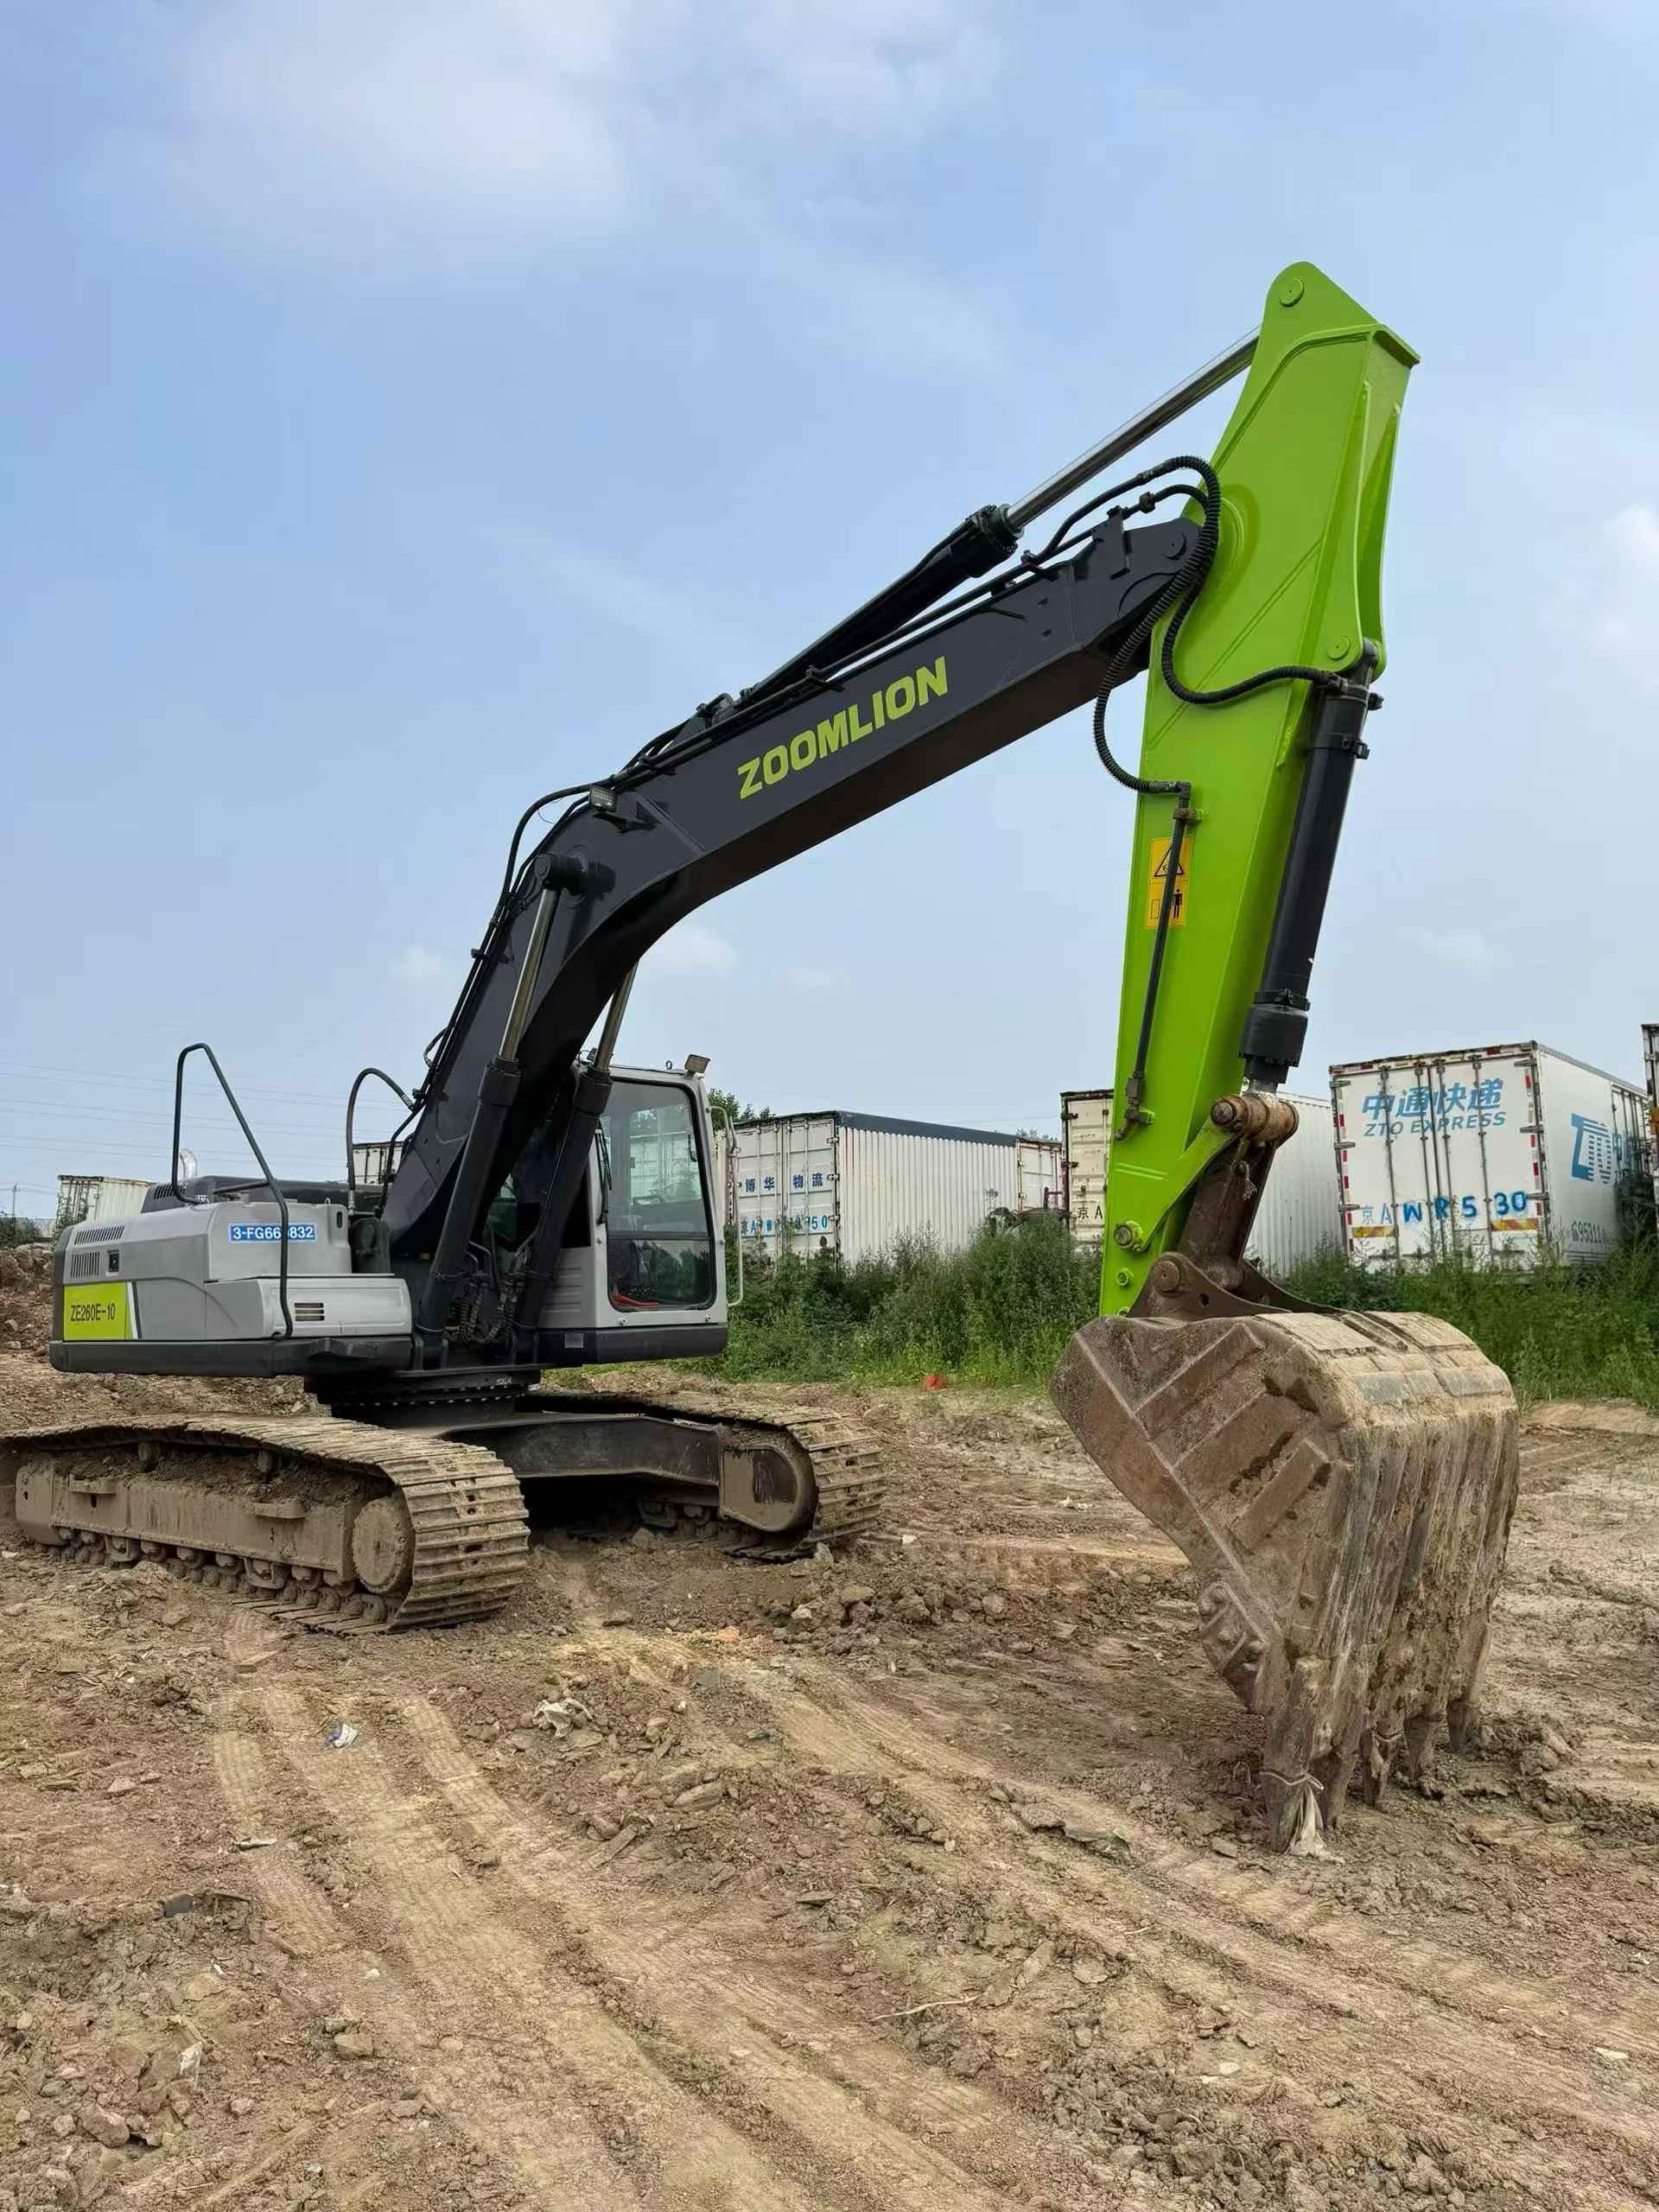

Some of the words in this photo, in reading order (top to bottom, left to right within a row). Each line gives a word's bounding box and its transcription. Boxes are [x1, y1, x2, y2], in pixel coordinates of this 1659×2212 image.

[737, 655, 949, 799] ZOOMLION
[1362, 1077, 1503, 1121] 中通快递
[1363, 1122, 1404, 1137] ZTO
[1410, 1111, 1507, 1134] EXPRESS
[233, 1226, 315, 1239] 3-FG66832
[70, 1303, 116, 1321] ZE260E-10
